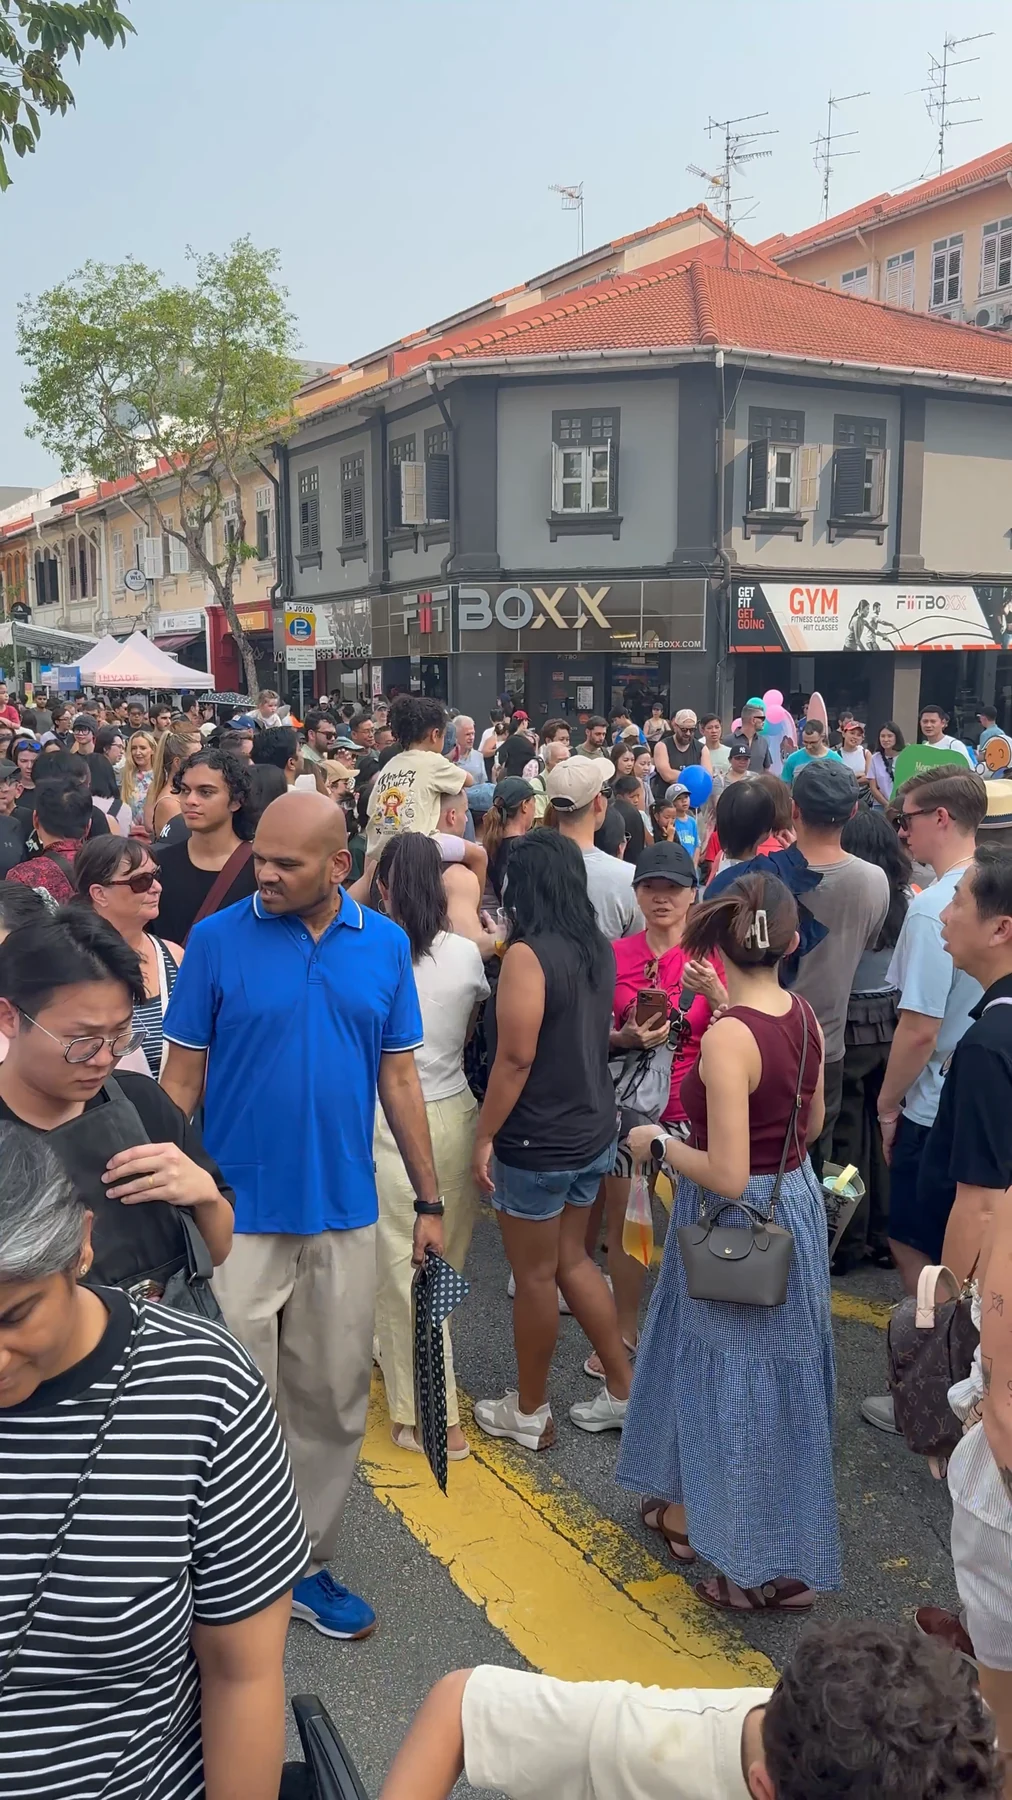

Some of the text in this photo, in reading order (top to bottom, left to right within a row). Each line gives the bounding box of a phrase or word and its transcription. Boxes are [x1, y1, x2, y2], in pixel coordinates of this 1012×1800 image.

[738, 587, 755, 598] GET
[738, 597, 752, 608] FIT
[789, 587, 839, 615] GYM
[737, 608, 755, 619] GET
[813, 615, 839, 623] COACHES
[737, 619, 765, 630] GOING
[814, 623, 839, 631] CLASSES
[273, 651, 287, 662] YO
